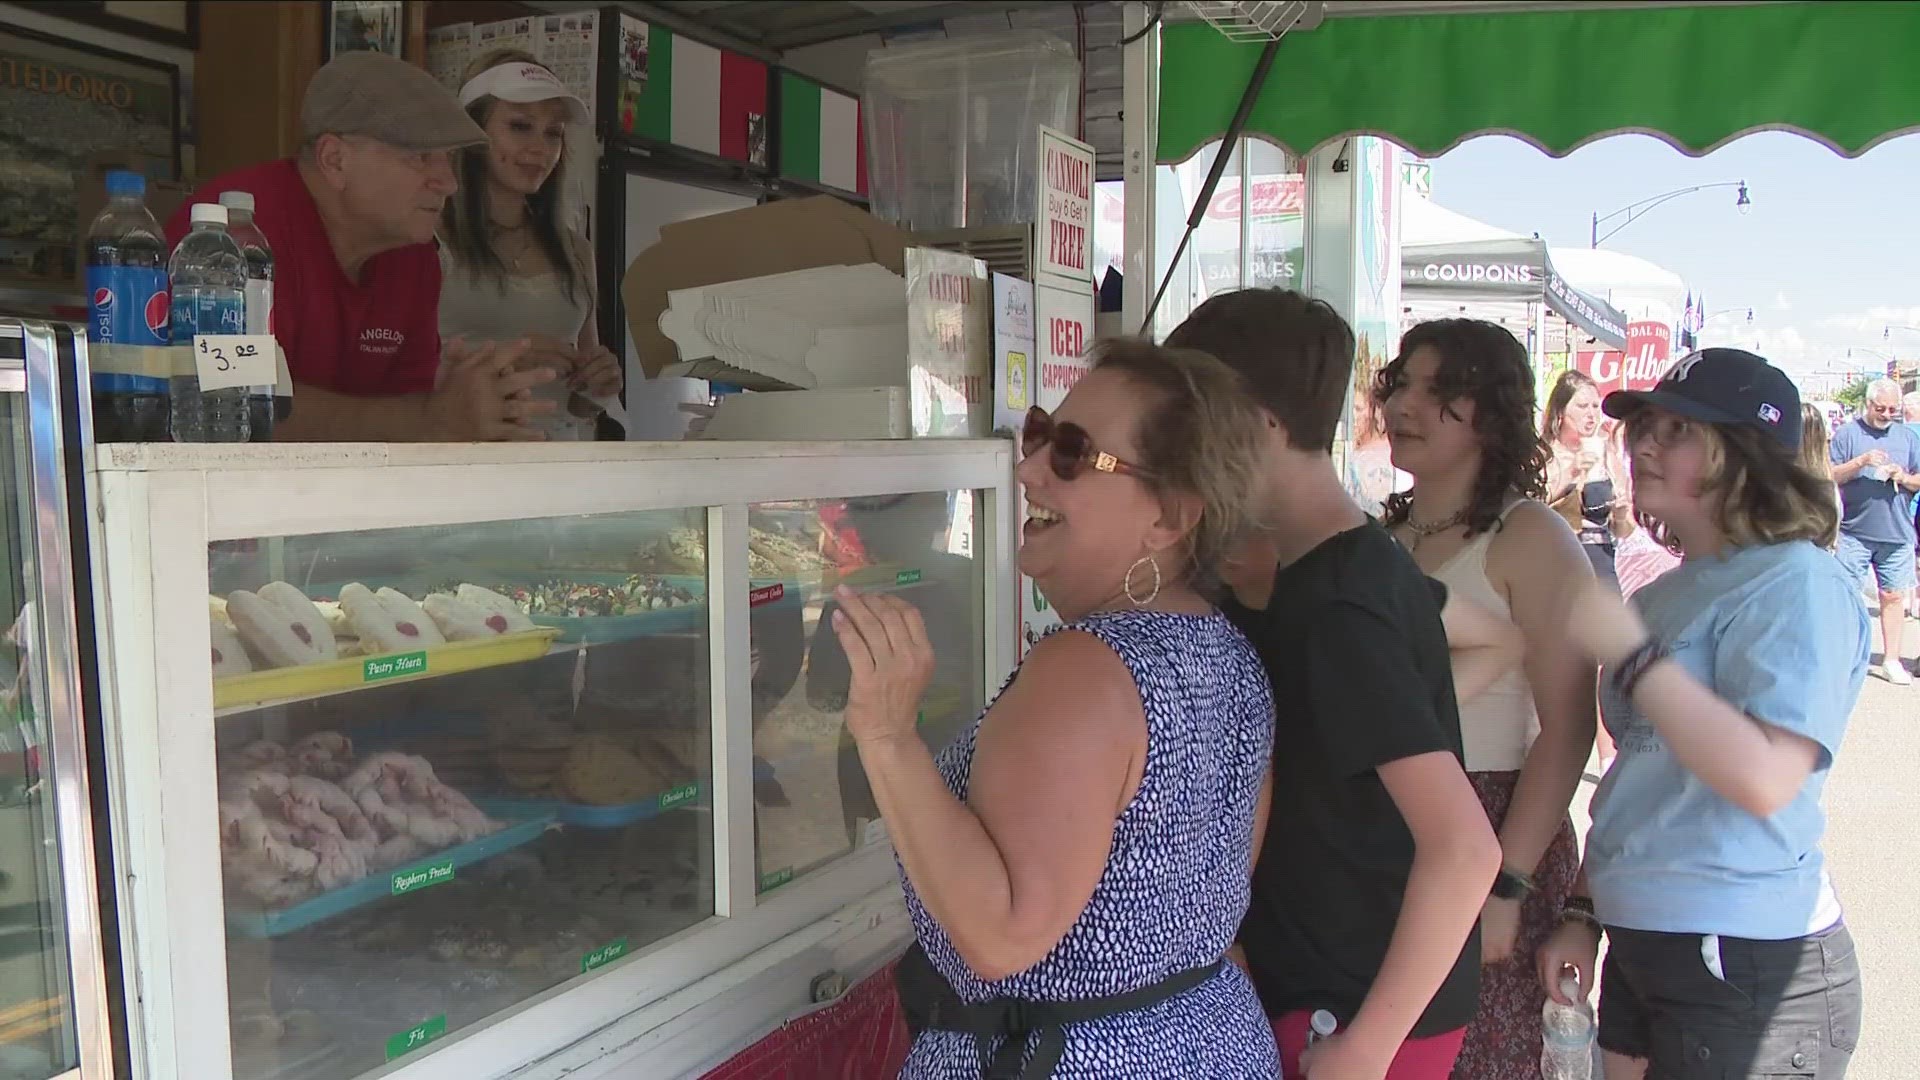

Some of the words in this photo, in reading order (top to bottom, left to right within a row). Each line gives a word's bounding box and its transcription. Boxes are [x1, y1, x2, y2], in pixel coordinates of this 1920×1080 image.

[1047, 148, 1089, 200] CANNOLI
[1048, 194, 1061, 219] Buy
[1063, 199, 1069, 216] 6
[1070, 201, 1082, 219] Get
[1049, 218, 1085, 270] FREE
[1423, 263, 1532, 282] COUPONS
[1050, 317, 1083, 358] ICED
[367, 662, 394, 676] Pastry
[394, 657, 423, 671] Hearts
[394, 872, 428, 891] Raspberry
